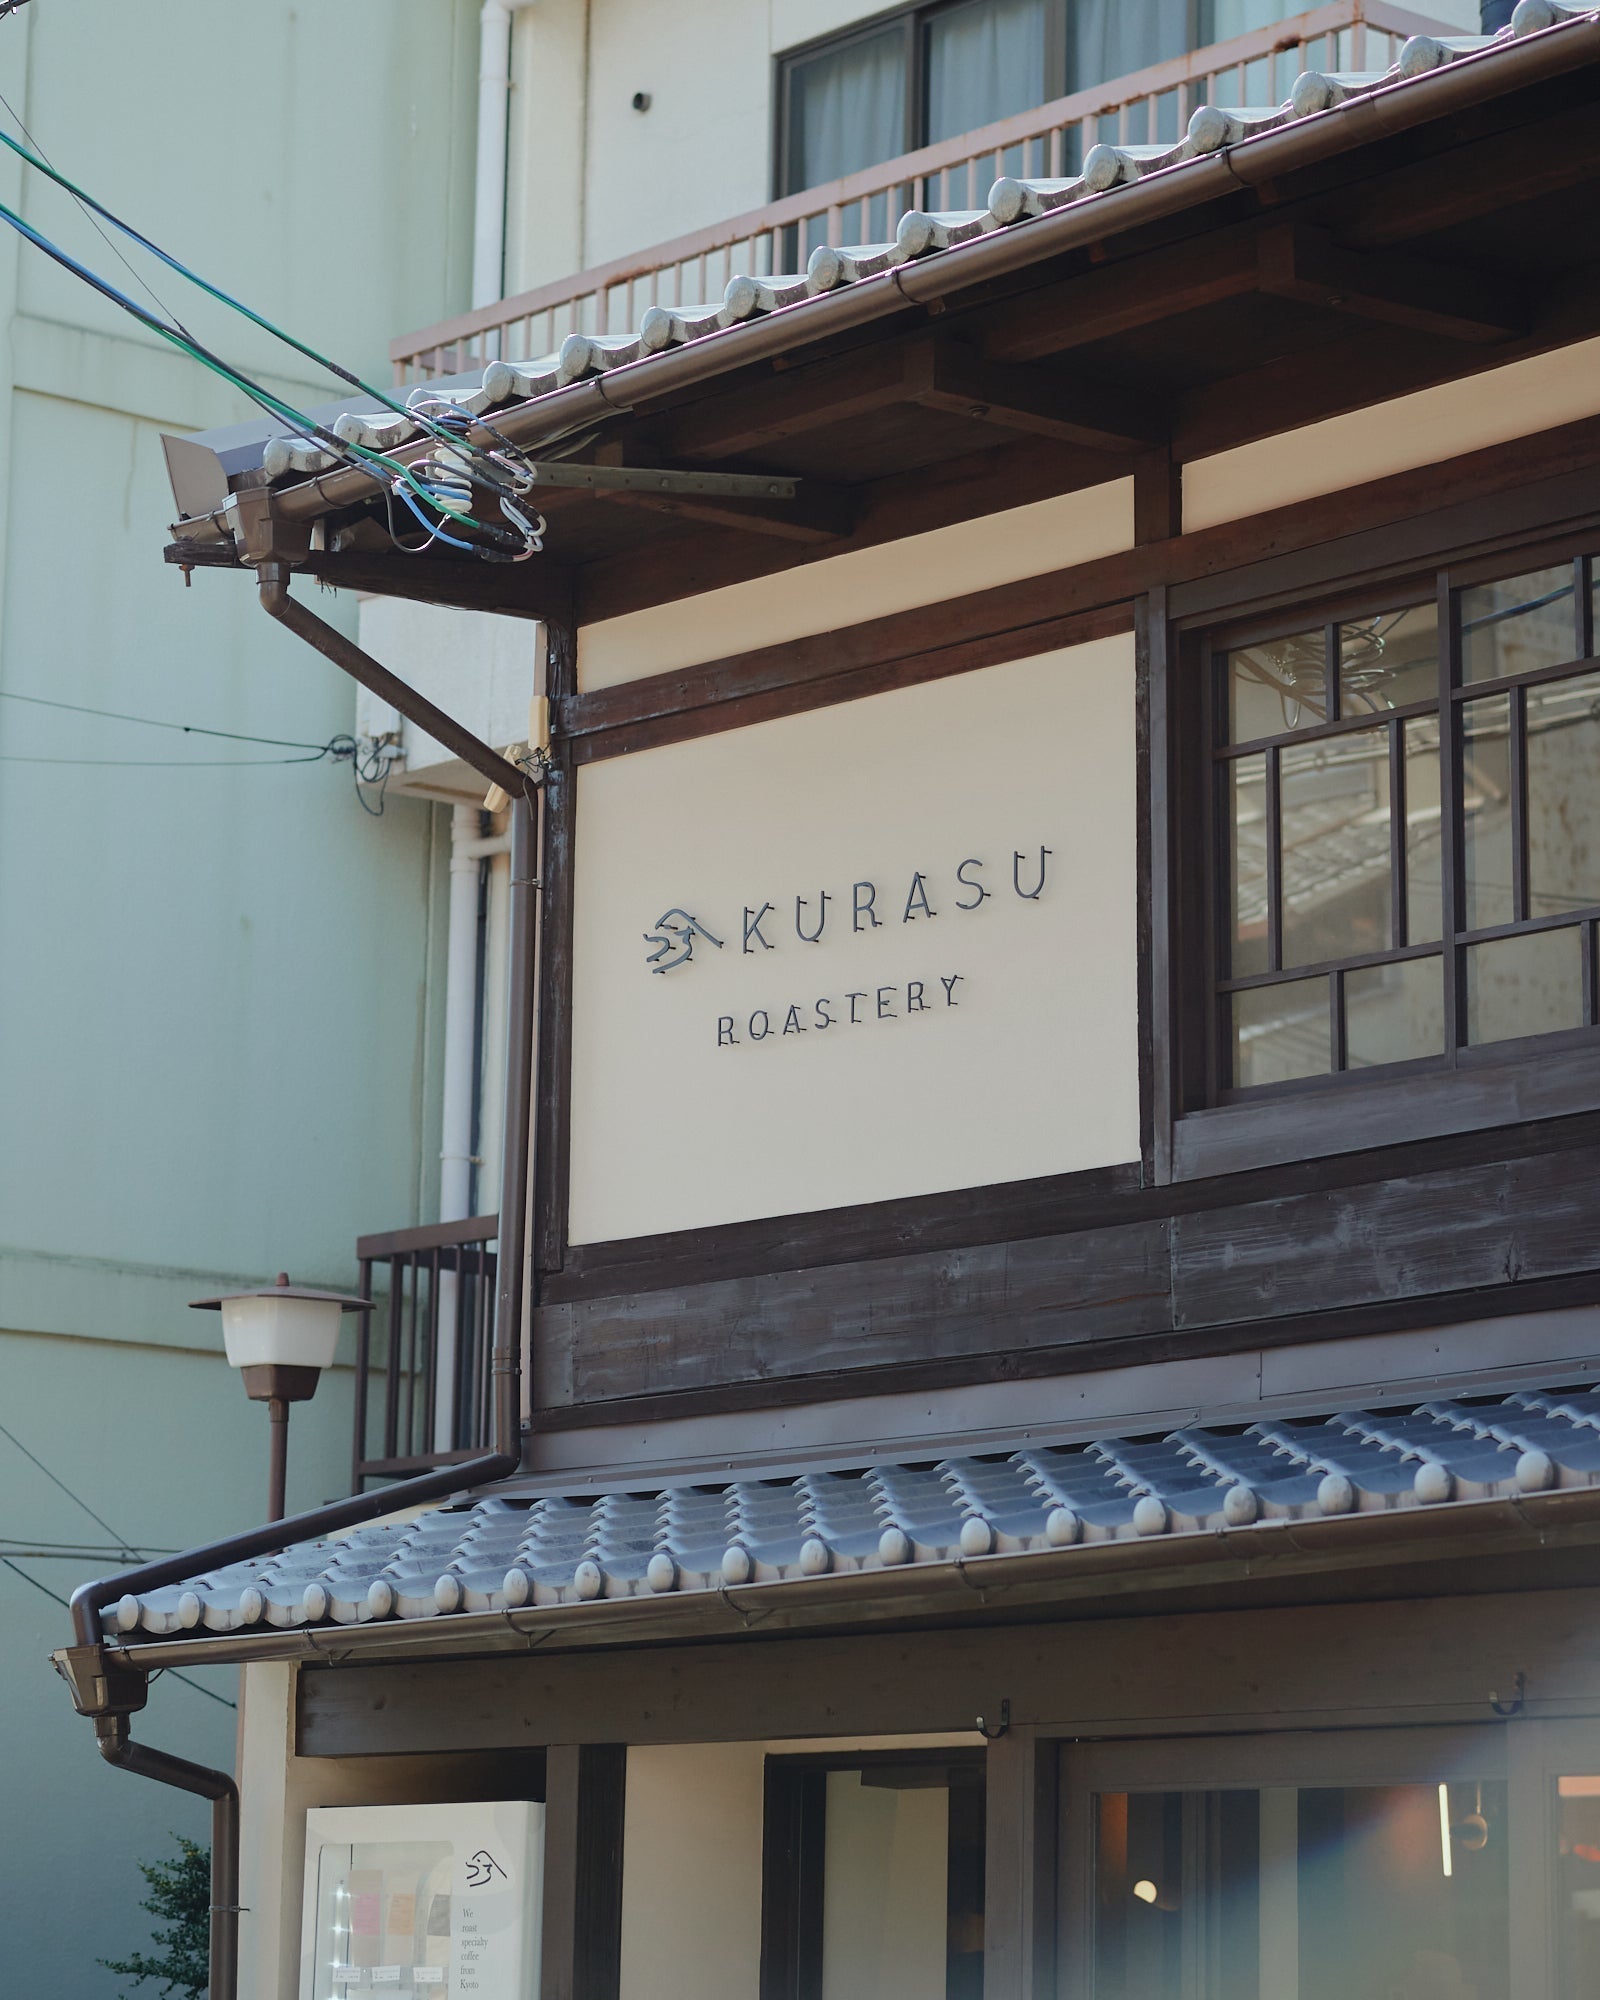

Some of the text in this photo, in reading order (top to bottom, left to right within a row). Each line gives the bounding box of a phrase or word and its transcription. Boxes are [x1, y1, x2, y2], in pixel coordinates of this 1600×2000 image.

[743, 845, 1049, 954] KURASU
[717, 974, 962, 1047] ROASTERY
[463, 1908, 474, 1918] We
[462, 1924, 478, 1933] roast
[461, 1937, 488, 1950] specialty
[461, 1950, 480, 1961] coffee
[460, 1965, 475, 1975] from
[460, 1979, 479, 1992] Kyoto
